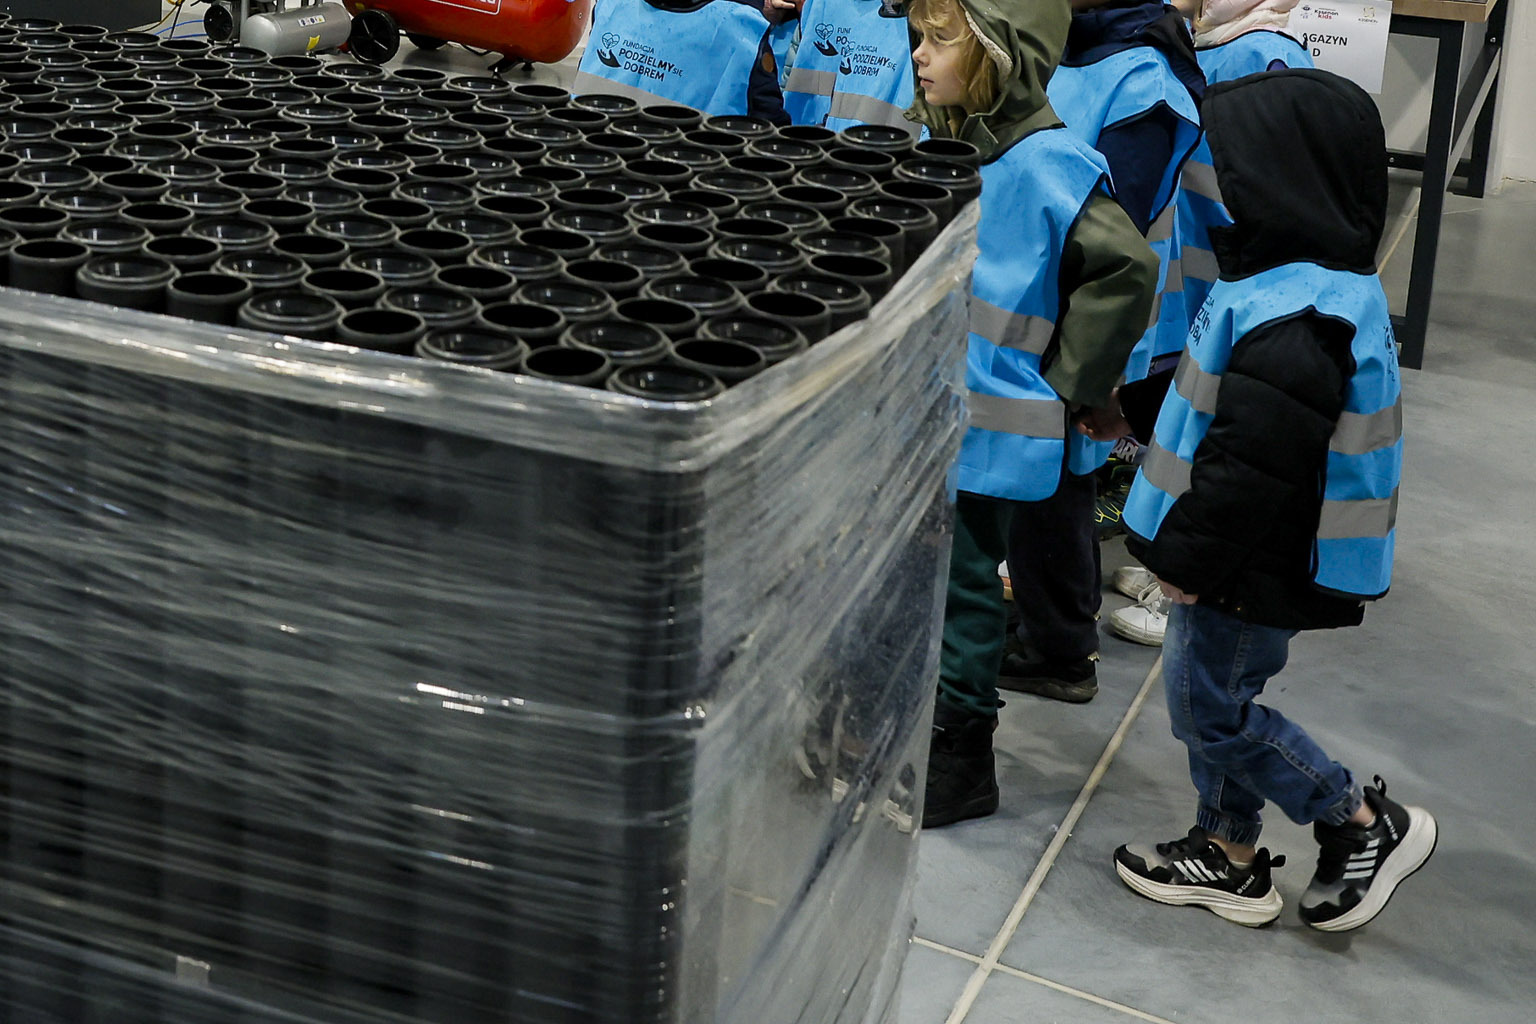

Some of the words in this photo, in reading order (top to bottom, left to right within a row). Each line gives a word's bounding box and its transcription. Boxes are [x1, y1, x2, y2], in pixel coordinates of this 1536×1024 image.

[623, 39, 655, 54] FUNDACJA
[1302, 32, 1348, 46] AGAZYN
[618, 48, 675, 72] PODZIELMY
[623, 61, 665, 82] DOBREM
